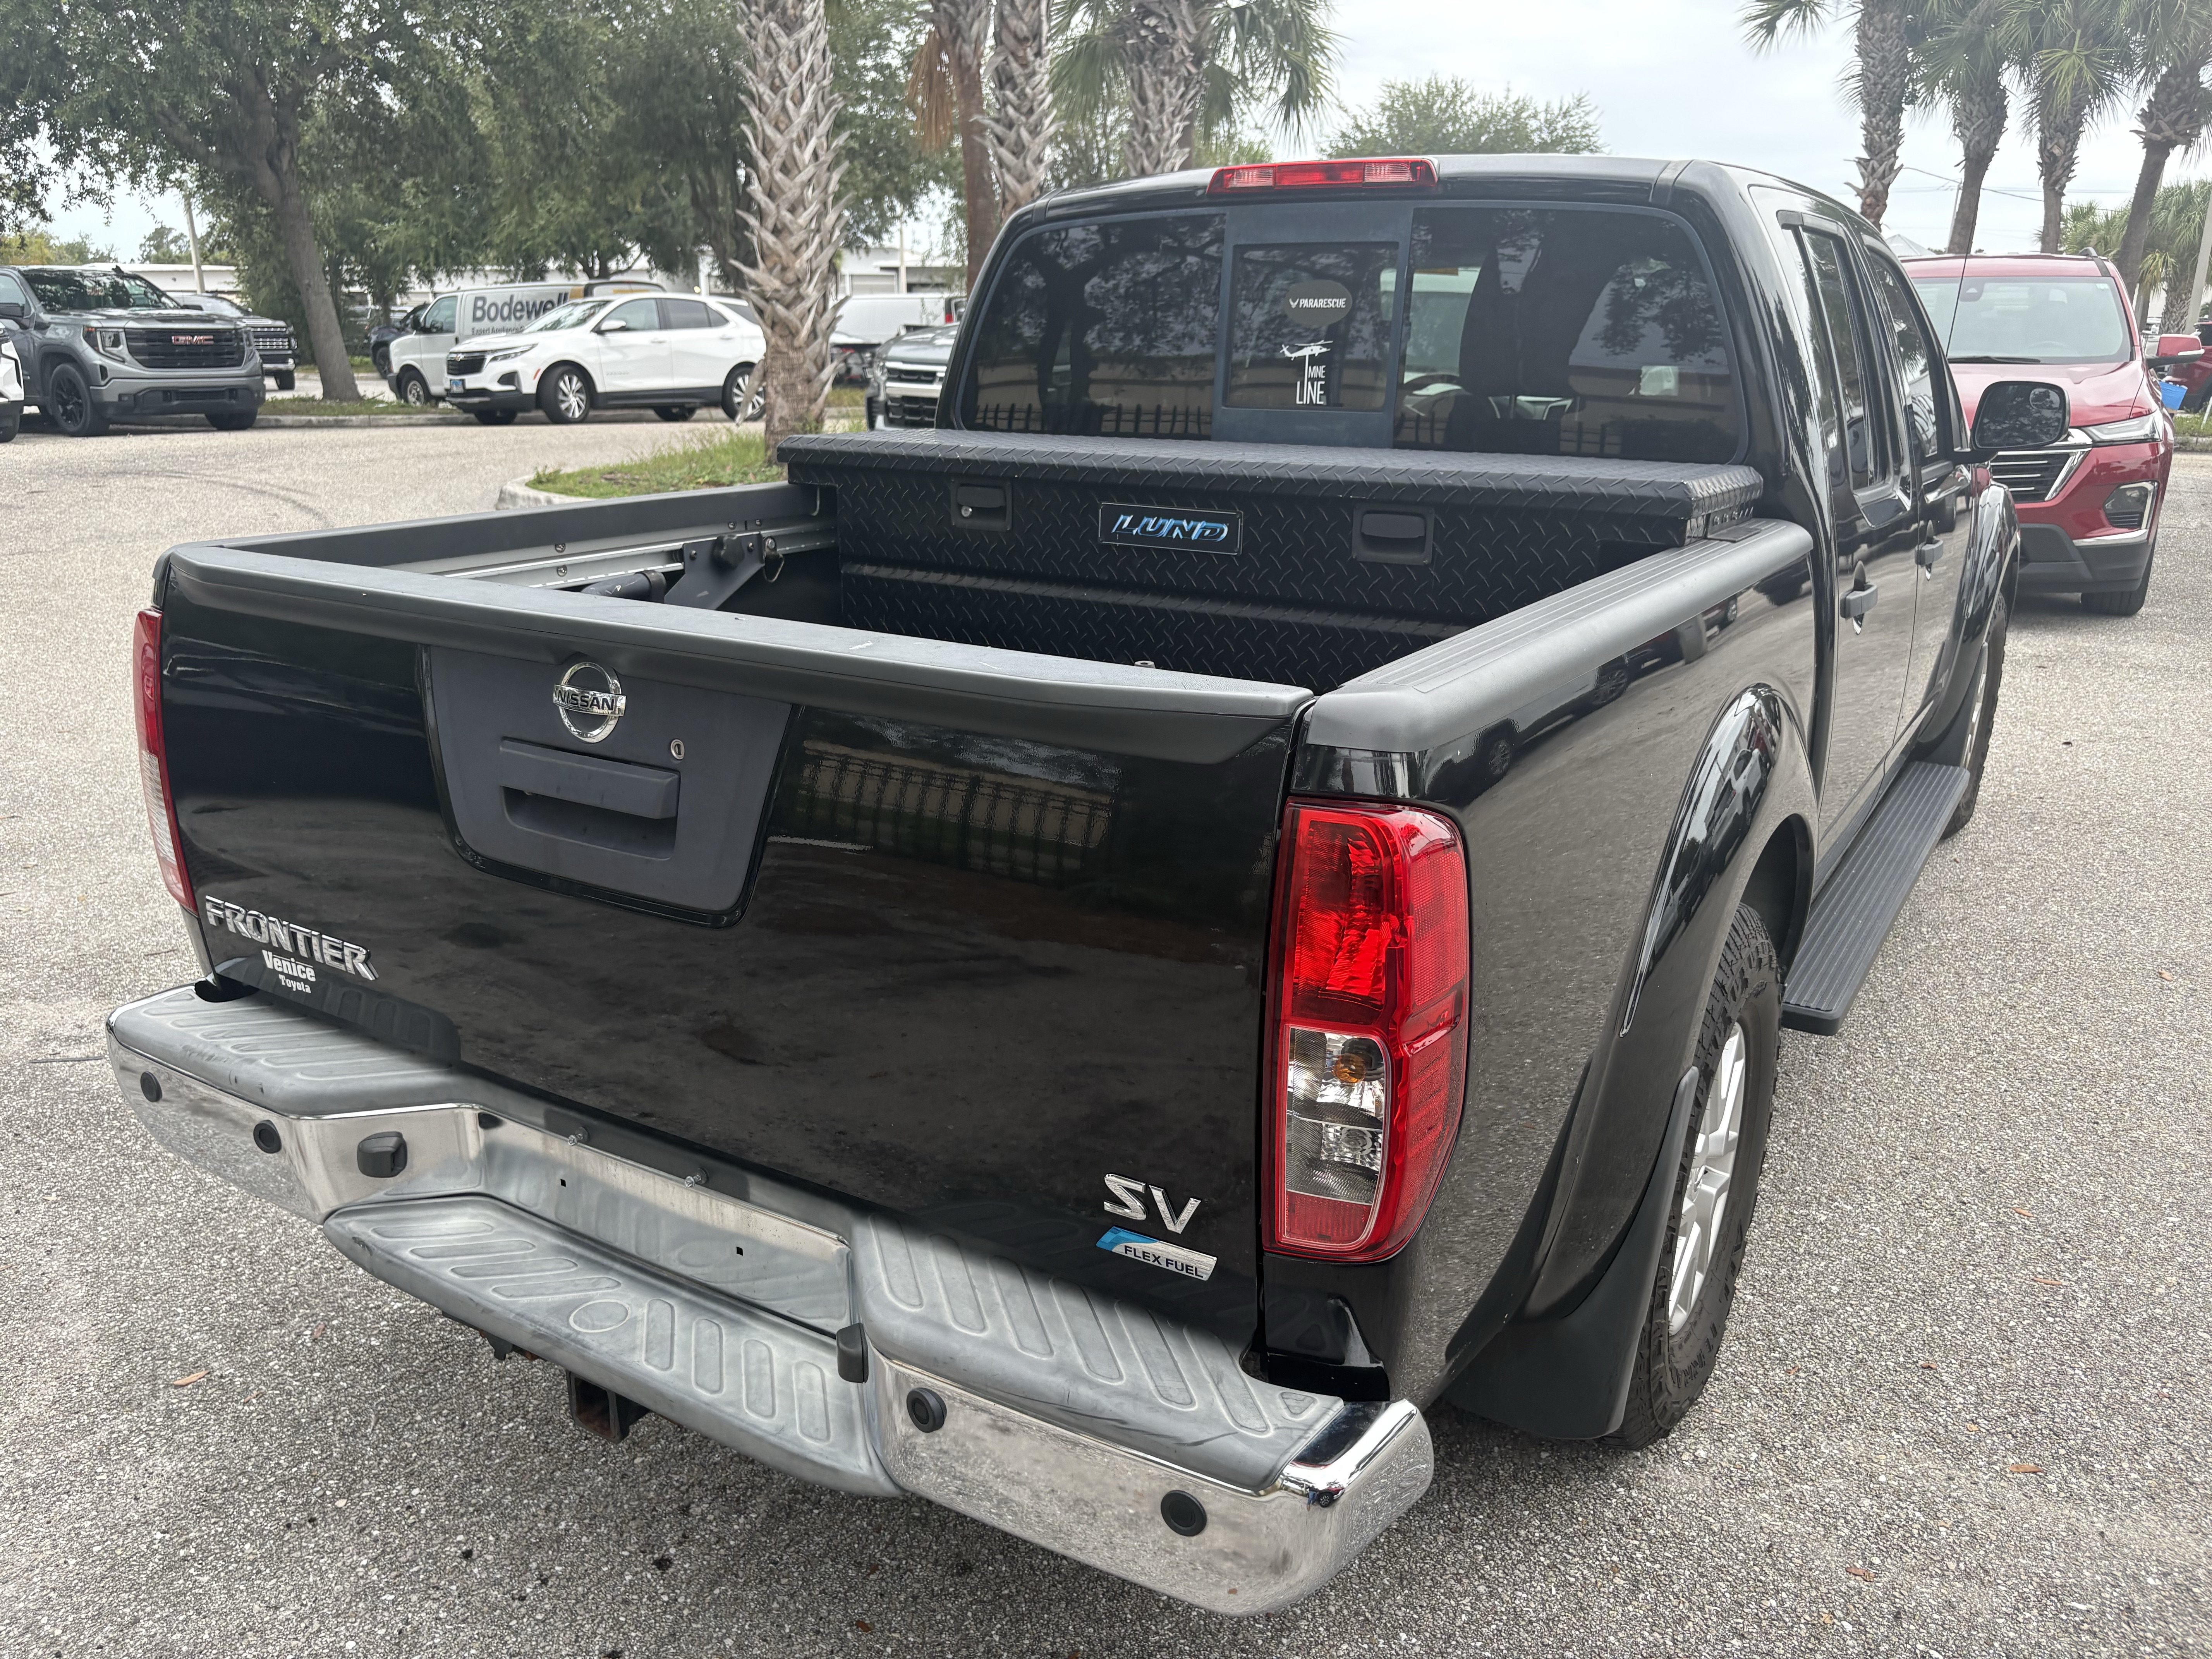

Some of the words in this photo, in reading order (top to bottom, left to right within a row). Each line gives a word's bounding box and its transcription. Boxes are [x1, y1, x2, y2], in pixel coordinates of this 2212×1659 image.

[1299, 298, 1346, 308] PARARESCUE
[172, 335, 214, 345] GMC
[1296, 381, 1325, 404] LINE
[1111, 514, 1228, 542] LUND
[556, 689, 615, 711] NISSAN
[205, 895, 380, 981] FRONTIER
[262, 949, 316, 982] Venice
[278, 974, 312, 994] Toyota
[1104, 1173, 1202, 1235] SV
[1124, 1245, 1162, 1266] FLEX
[1165, 1258, 1204, 1279] FUEL
